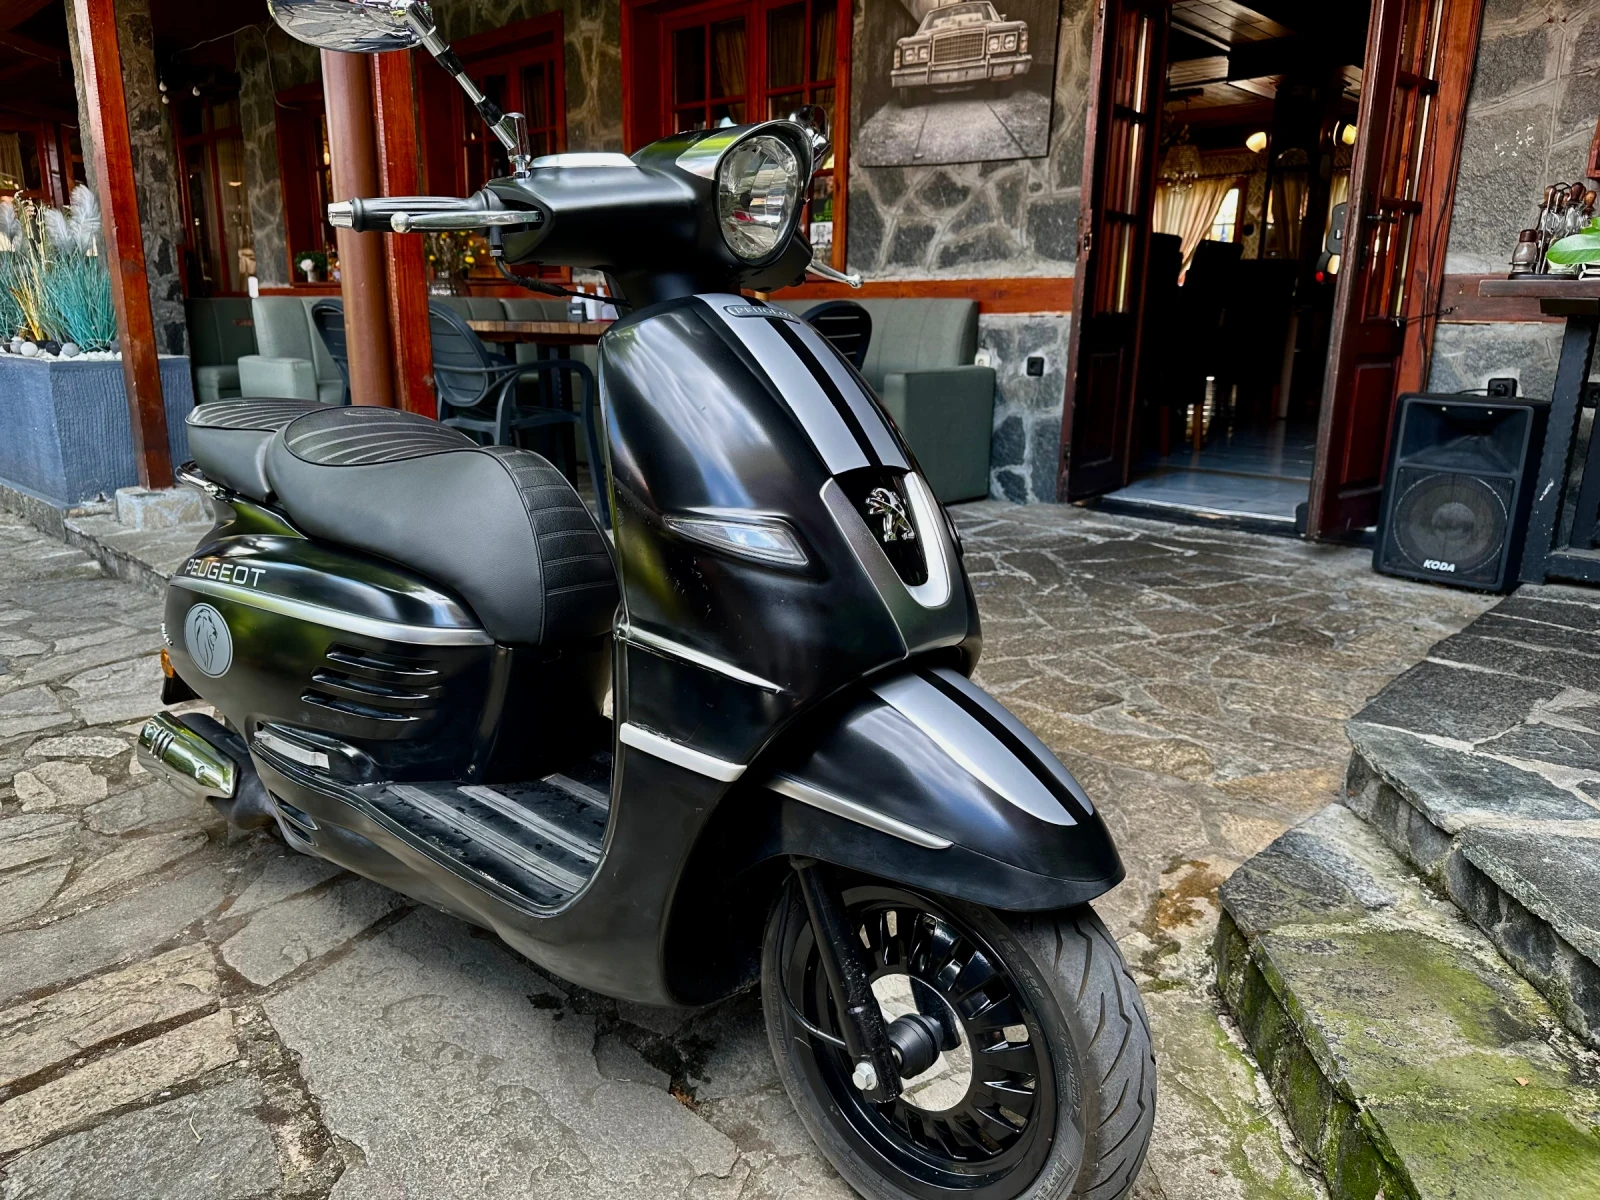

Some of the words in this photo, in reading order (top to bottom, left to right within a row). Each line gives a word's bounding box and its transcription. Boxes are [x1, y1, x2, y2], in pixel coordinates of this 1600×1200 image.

[735, 306, 794, 320] PEUGEOT
[185, 558, 266, 587] PEUGEOT
[1423, 559, 1456, 573] KODA
